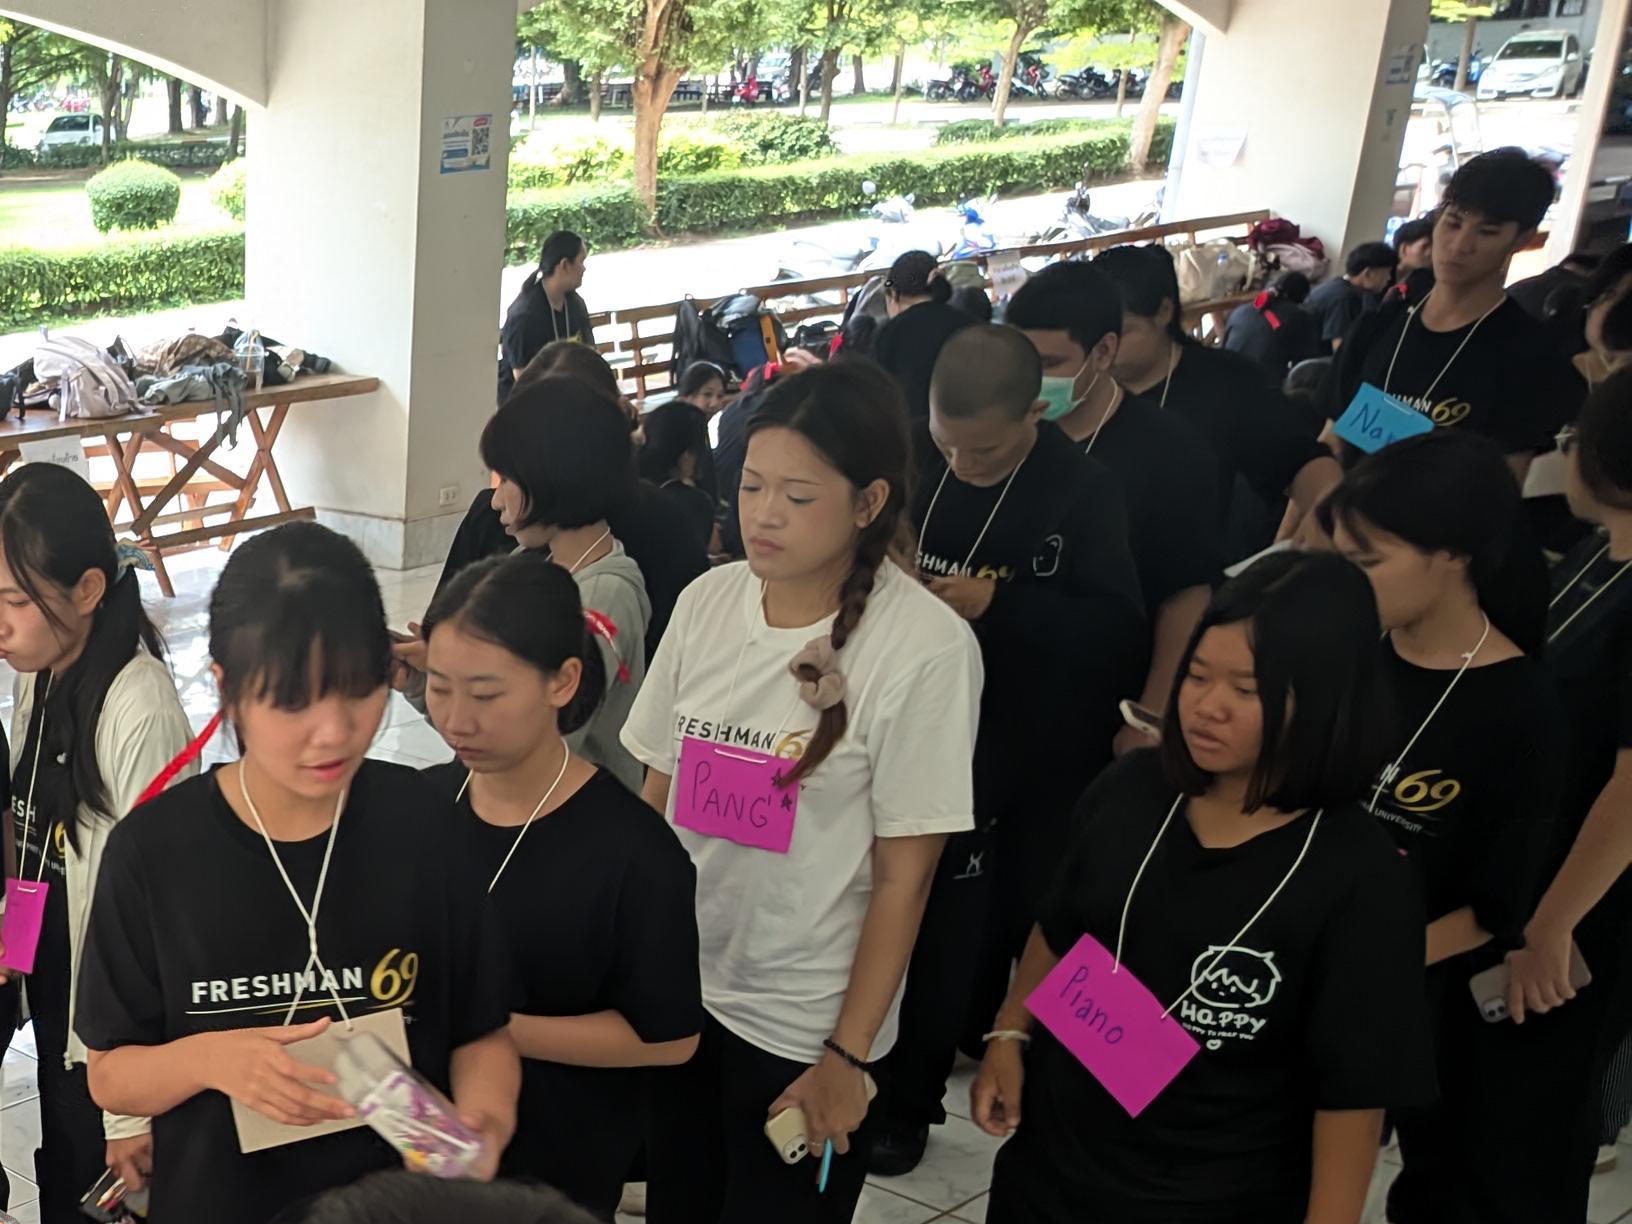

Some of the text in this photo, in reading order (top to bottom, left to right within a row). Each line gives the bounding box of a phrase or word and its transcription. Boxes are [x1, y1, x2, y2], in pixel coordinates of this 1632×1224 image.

[1432, 396, 1471, 427] 69
[1393, 769, 1461, 812] 69
[191, 948, 419, 1009] FRESHMAN 69
[1057, 965, 1125, 1046] Piano
